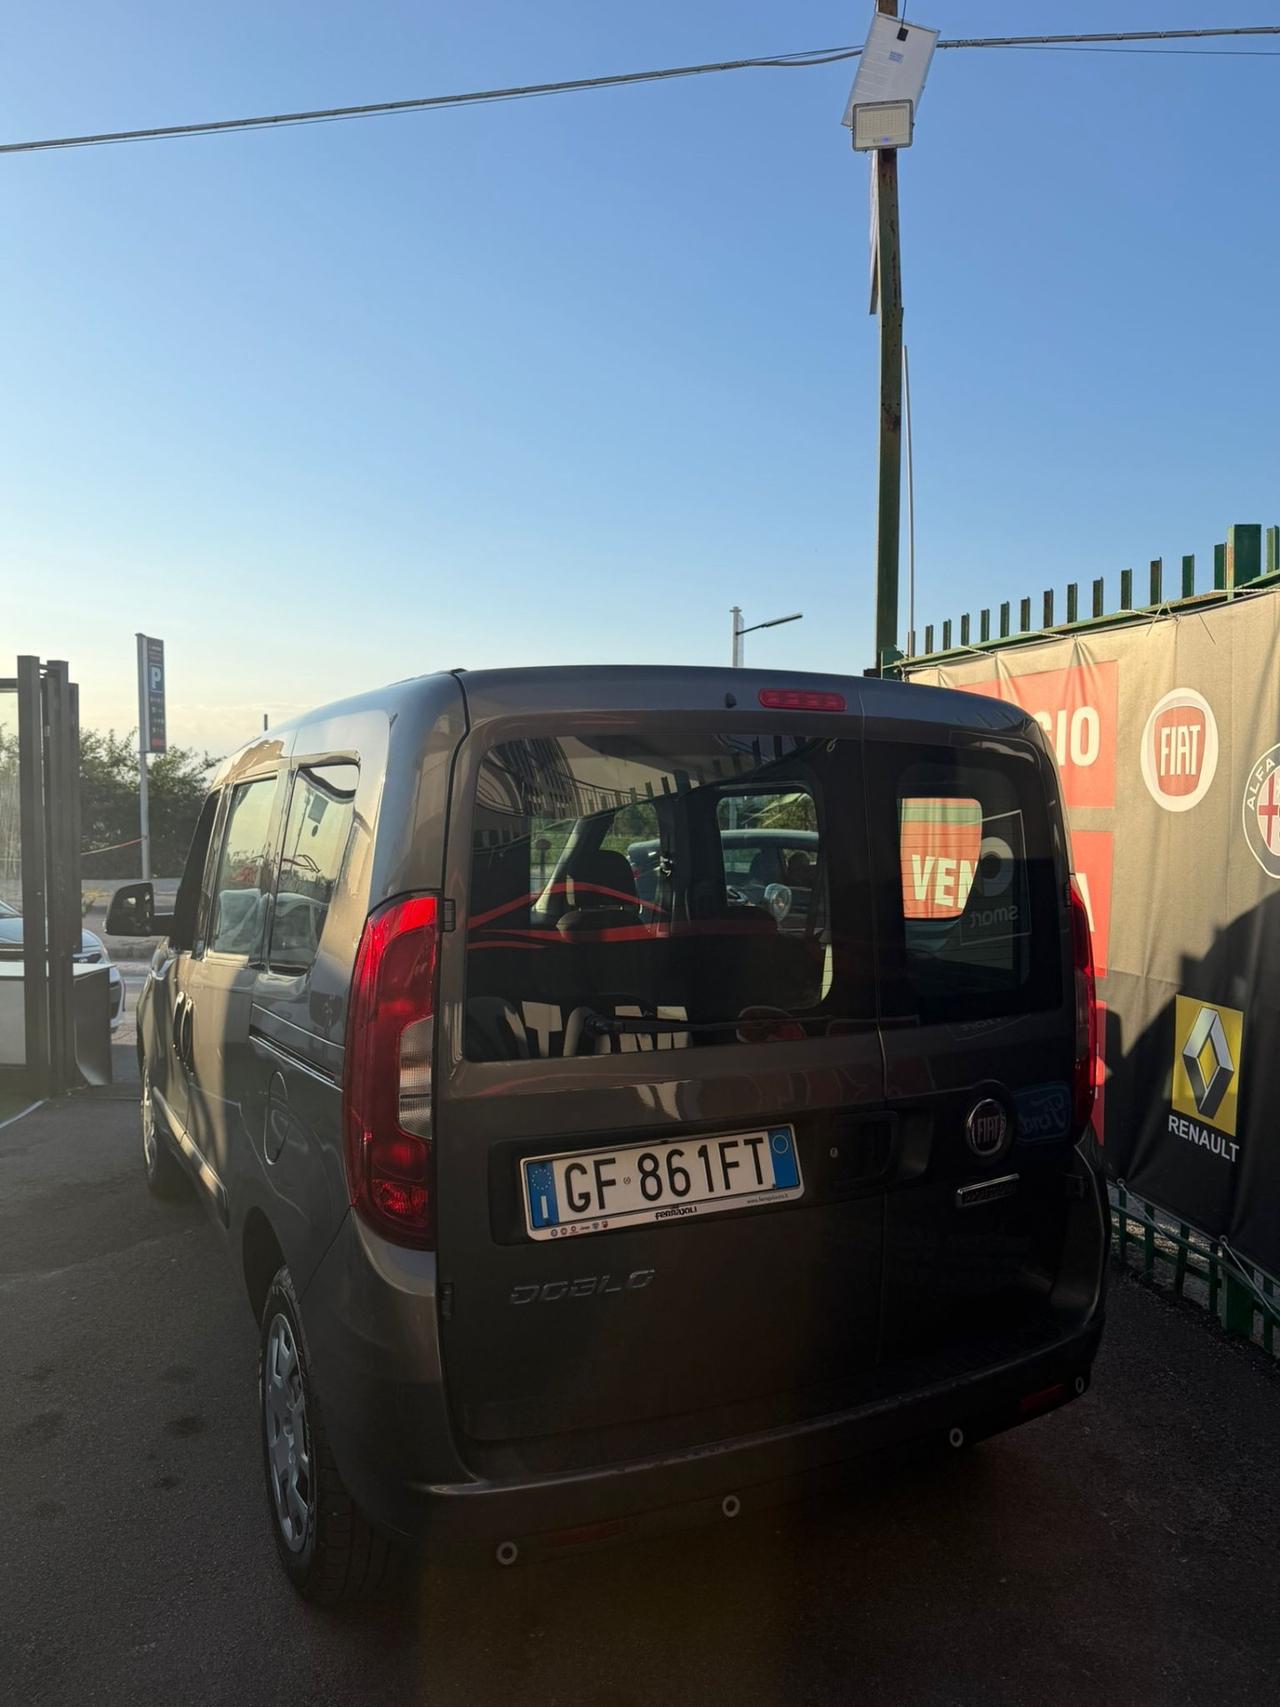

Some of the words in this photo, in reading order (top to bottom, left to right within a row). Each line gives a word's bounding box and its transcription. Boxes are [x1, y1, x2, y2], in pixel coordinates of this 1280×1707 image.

[151, 666, 162, 689] P
[1159, 724, 1202, 777] FIAT
[1246, 758, 1276, 811] ALFA
[976, 1115, 999, 1145] FIAT
[1168, 1114, 1240, 1163] RENAULT
[564, 1157, 617, 1214] GF
[636, 1137, 765, 1202] 861FT
